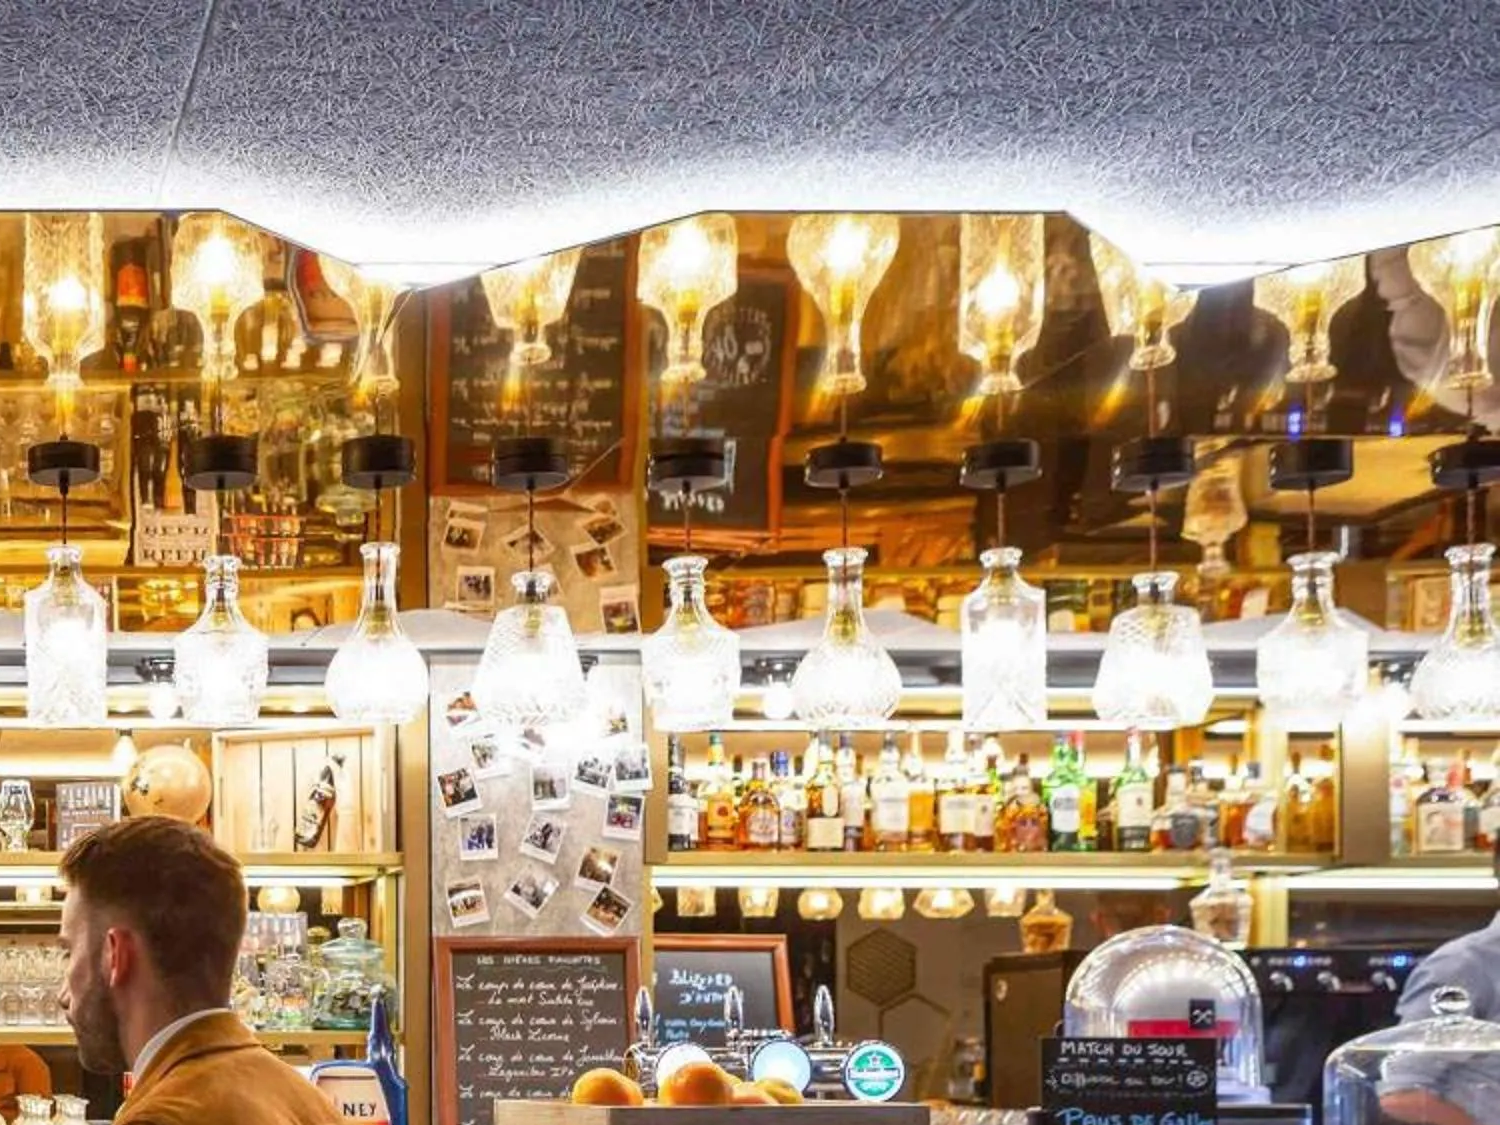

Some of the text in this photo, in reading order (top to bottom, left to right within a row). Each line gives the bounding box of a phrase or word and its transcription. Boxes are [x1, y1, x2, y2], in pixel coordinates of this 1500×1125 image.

[1061, 1042, 1189, 1057] MATCH DU JOUR
[342, 1103, 377, 1117] NEY
